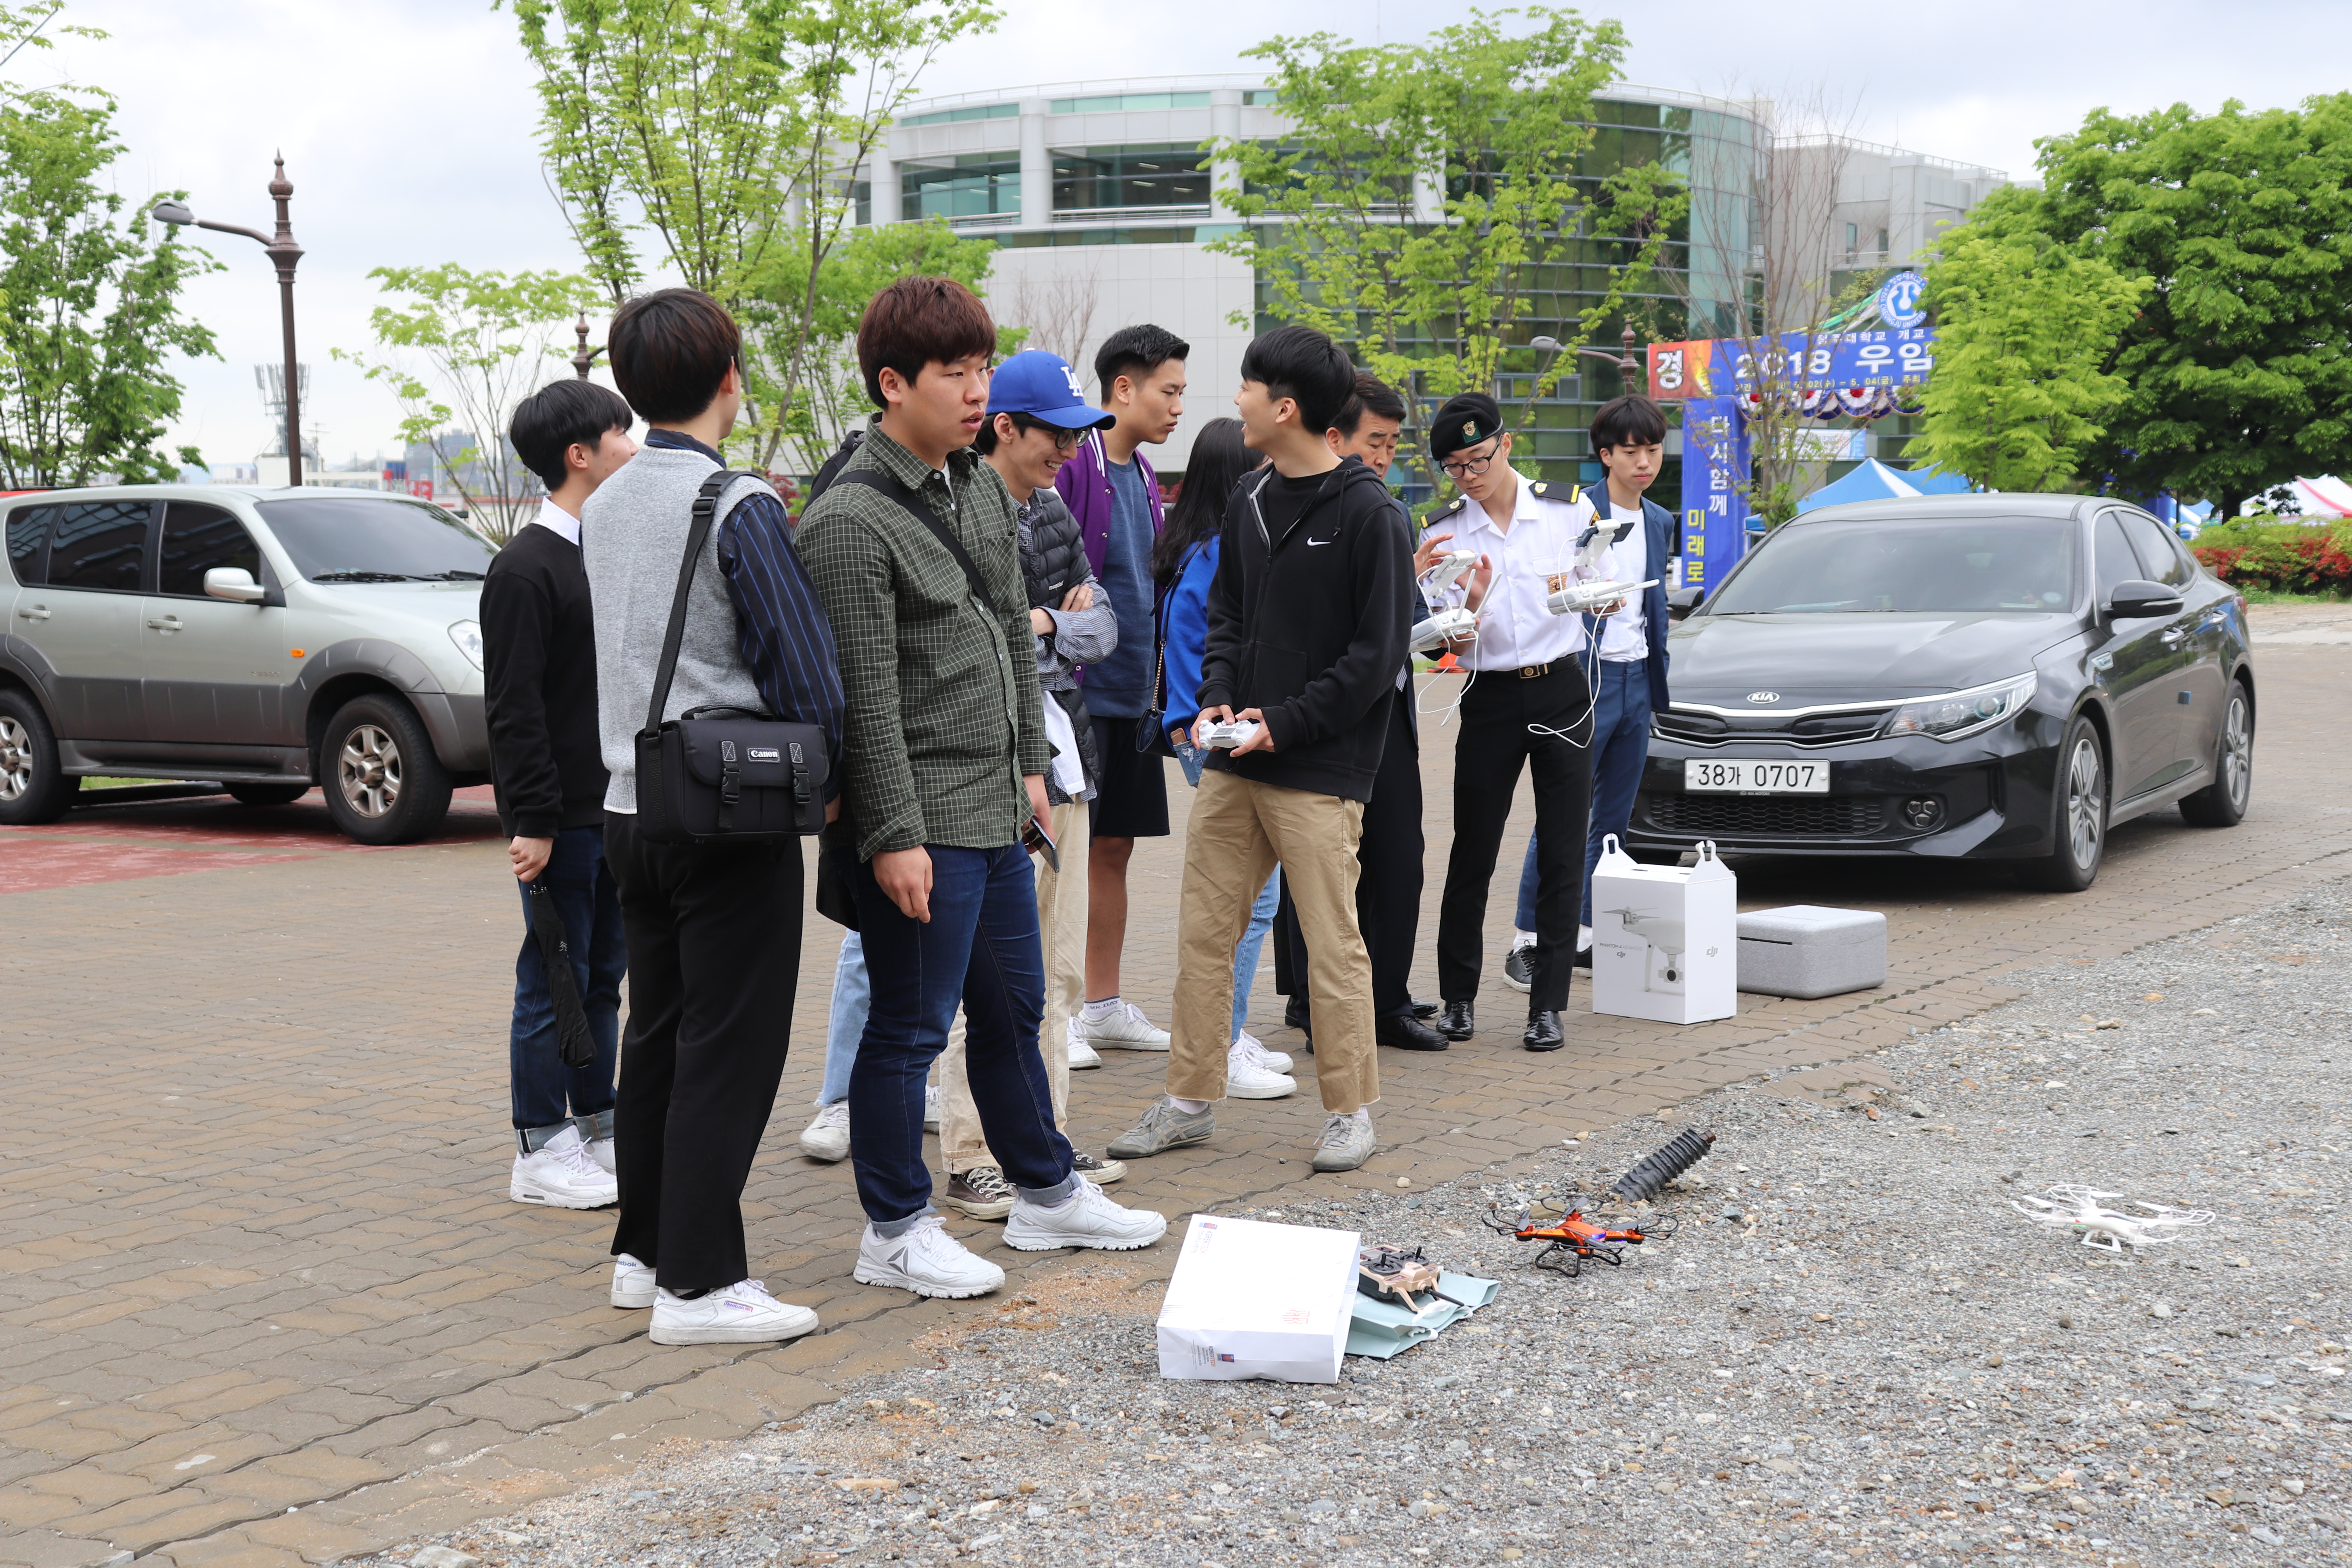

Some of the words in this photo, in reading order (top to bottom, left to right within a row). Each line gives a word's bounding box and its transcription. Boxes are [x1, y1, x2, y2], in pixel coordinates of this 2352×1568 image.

[1880, 304, 1901, 327] CHEONGJU
[1903, 312, 1927, 328] UNIVERS
[1898, 329, 1925, 340] 개교
[1656, 349, 1683, 390] 경
[1736, 349, 1831, 378] 2018
[1866, 375, 1894, 385] 04(금)
[1903, 374, 1920, 383] 주최
[1687, 509, 1705, 582] 미래로
[1698, 764, 1741, 785] 38가
[1755, 765, 1815, 787] 0707
[725, 1301, 744, 1310] Reebok
